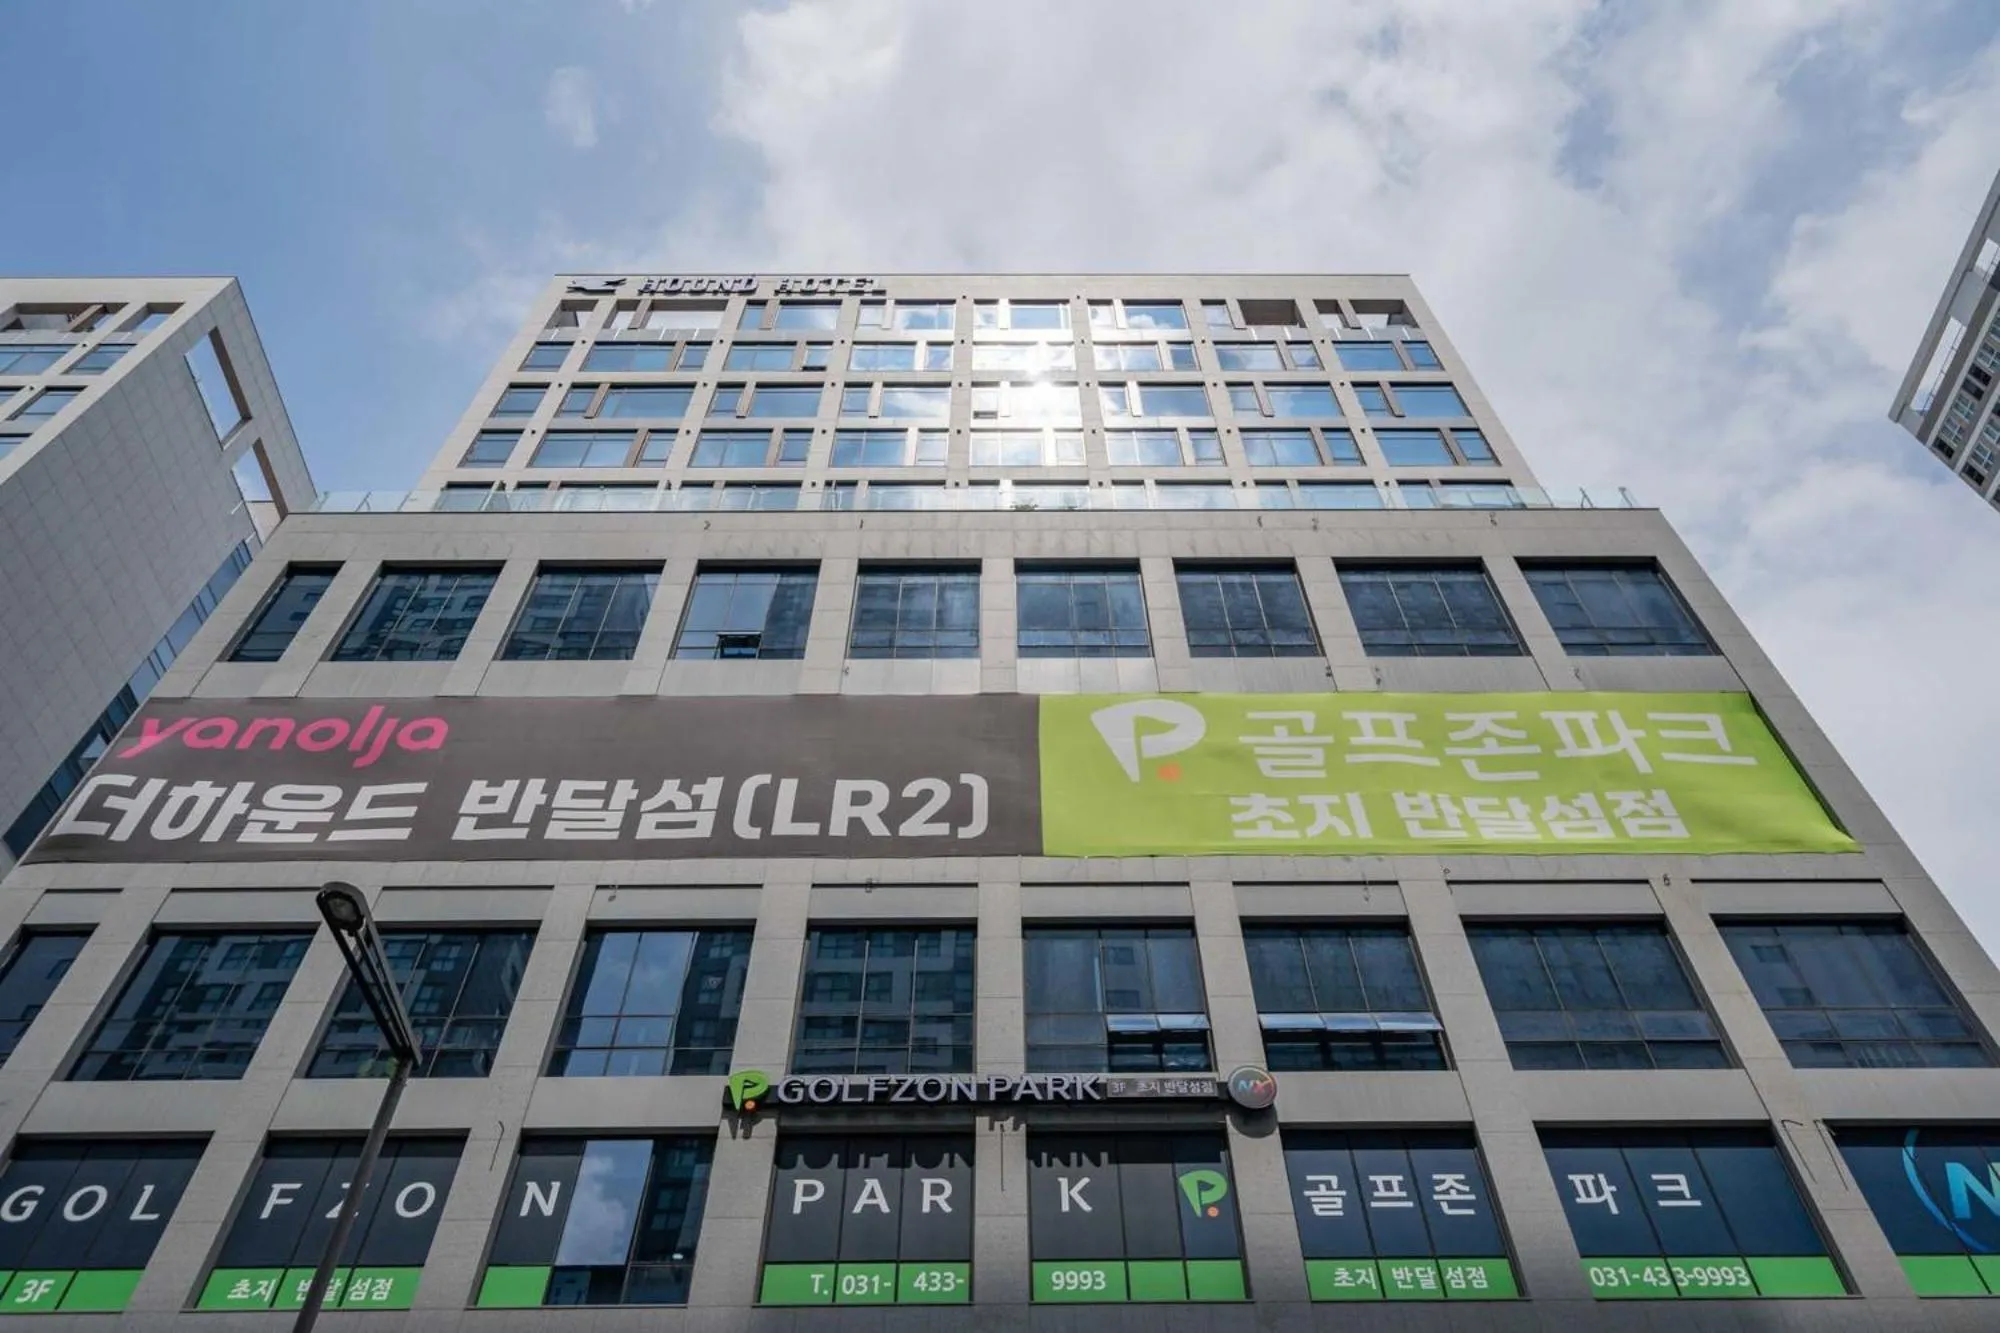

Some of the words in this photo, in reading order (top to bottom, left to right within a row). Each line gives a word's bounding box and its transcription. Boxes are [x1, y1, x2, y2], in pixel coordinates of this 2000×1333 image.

[119, 705, 449, 769] yanolja
[1239, 710, 1757, 781] 골프존파크
[49, 773, 428, 843] 더하운드
[1229, 792, 1374, 839] 초지
[1393, 788, 1691, 842] 반달섬점
[777, 1075, 979, 1103] GOLFZON
[988, 1074, 1102, 1101] PARK
[15, 1279, 55, 1303] 3F
[227, 1278, 278, 1303] 초지
[1333, 1266, 1378, 1290] 초지
[1589, 1265, 1751, 1288] 031-433-9993
